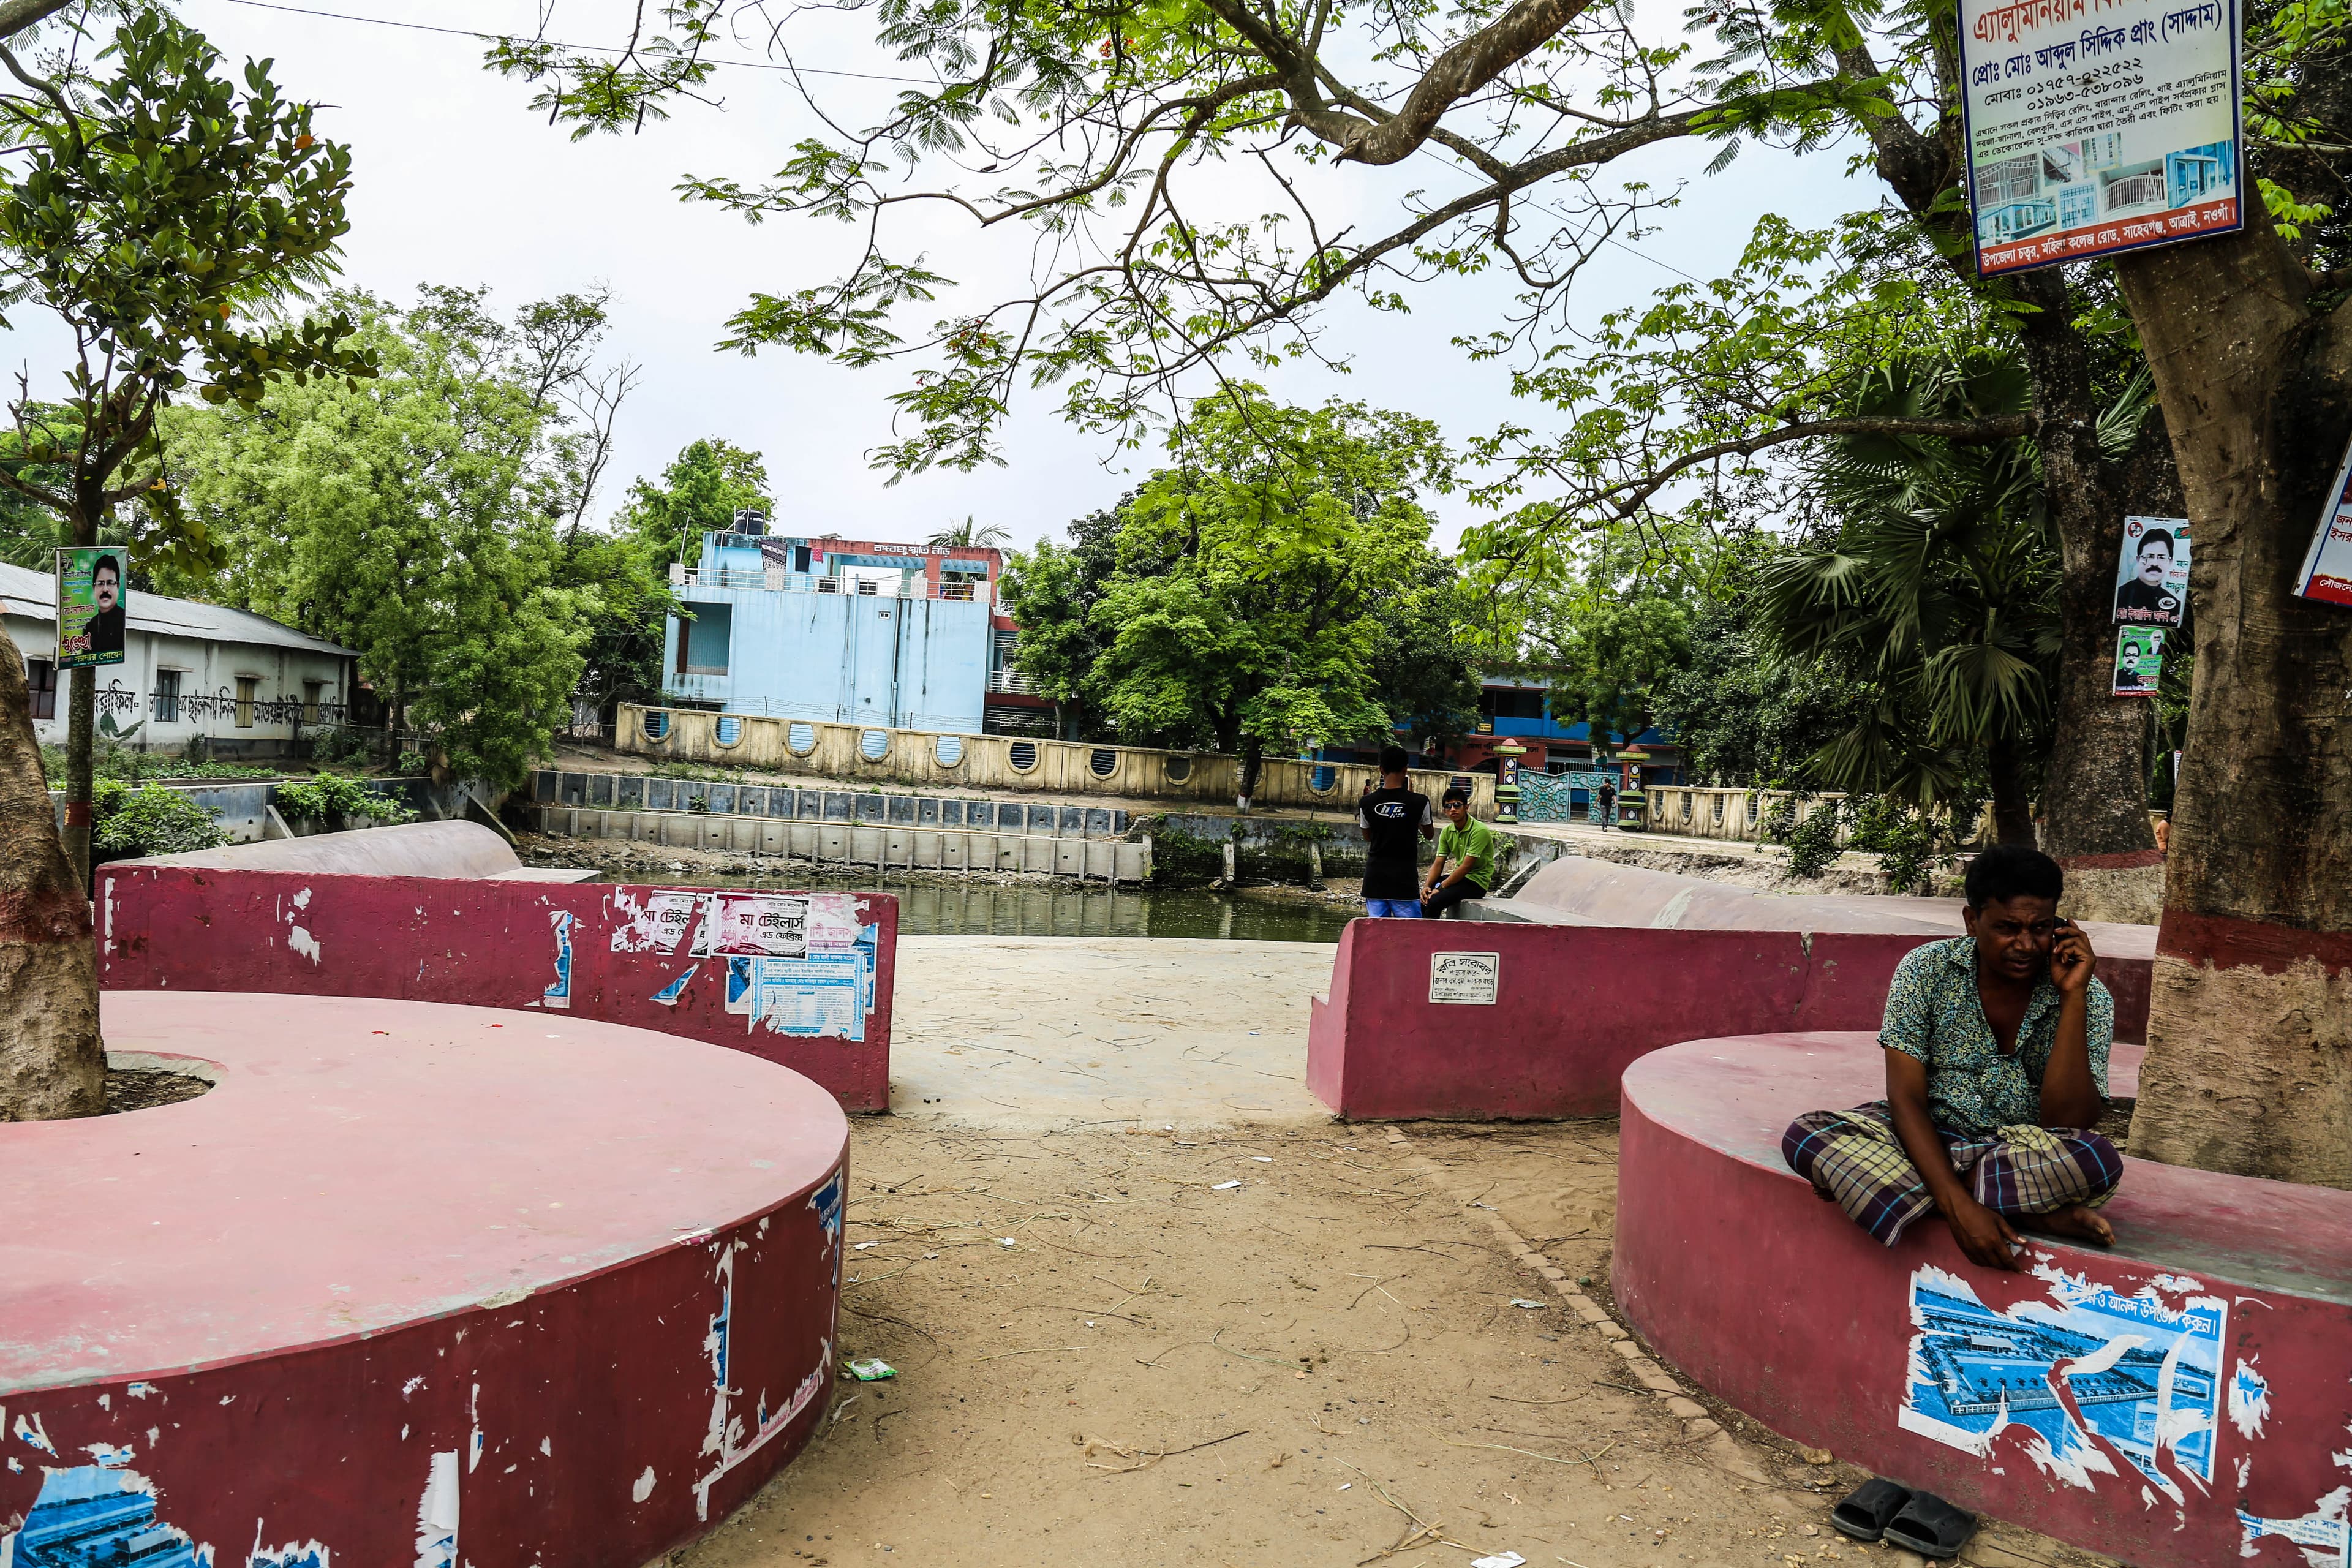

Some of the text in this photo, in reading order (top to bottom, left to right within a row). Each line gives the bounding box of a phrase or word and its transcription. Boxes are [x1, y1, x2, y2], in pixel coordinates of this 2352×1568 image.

[2005, 53, 2031, 78] মোঃ
[2080, 26, 2125, 59] সিদ্দিক
[1985, 88, 2021, 106] মোবাঃ
[1975, 126, 1998, 137] এখানে
[2000, 121, 2019, 130] সকল
[1982, 249, 2016, 268] উপজেলা
[2068, 234, 2095, 249] কলেজ
[739, 914, 755, 925] মা
[1436, 959, 1456, 973] রবি
[2108, 1295, 2138, 1316] আনন্দ
